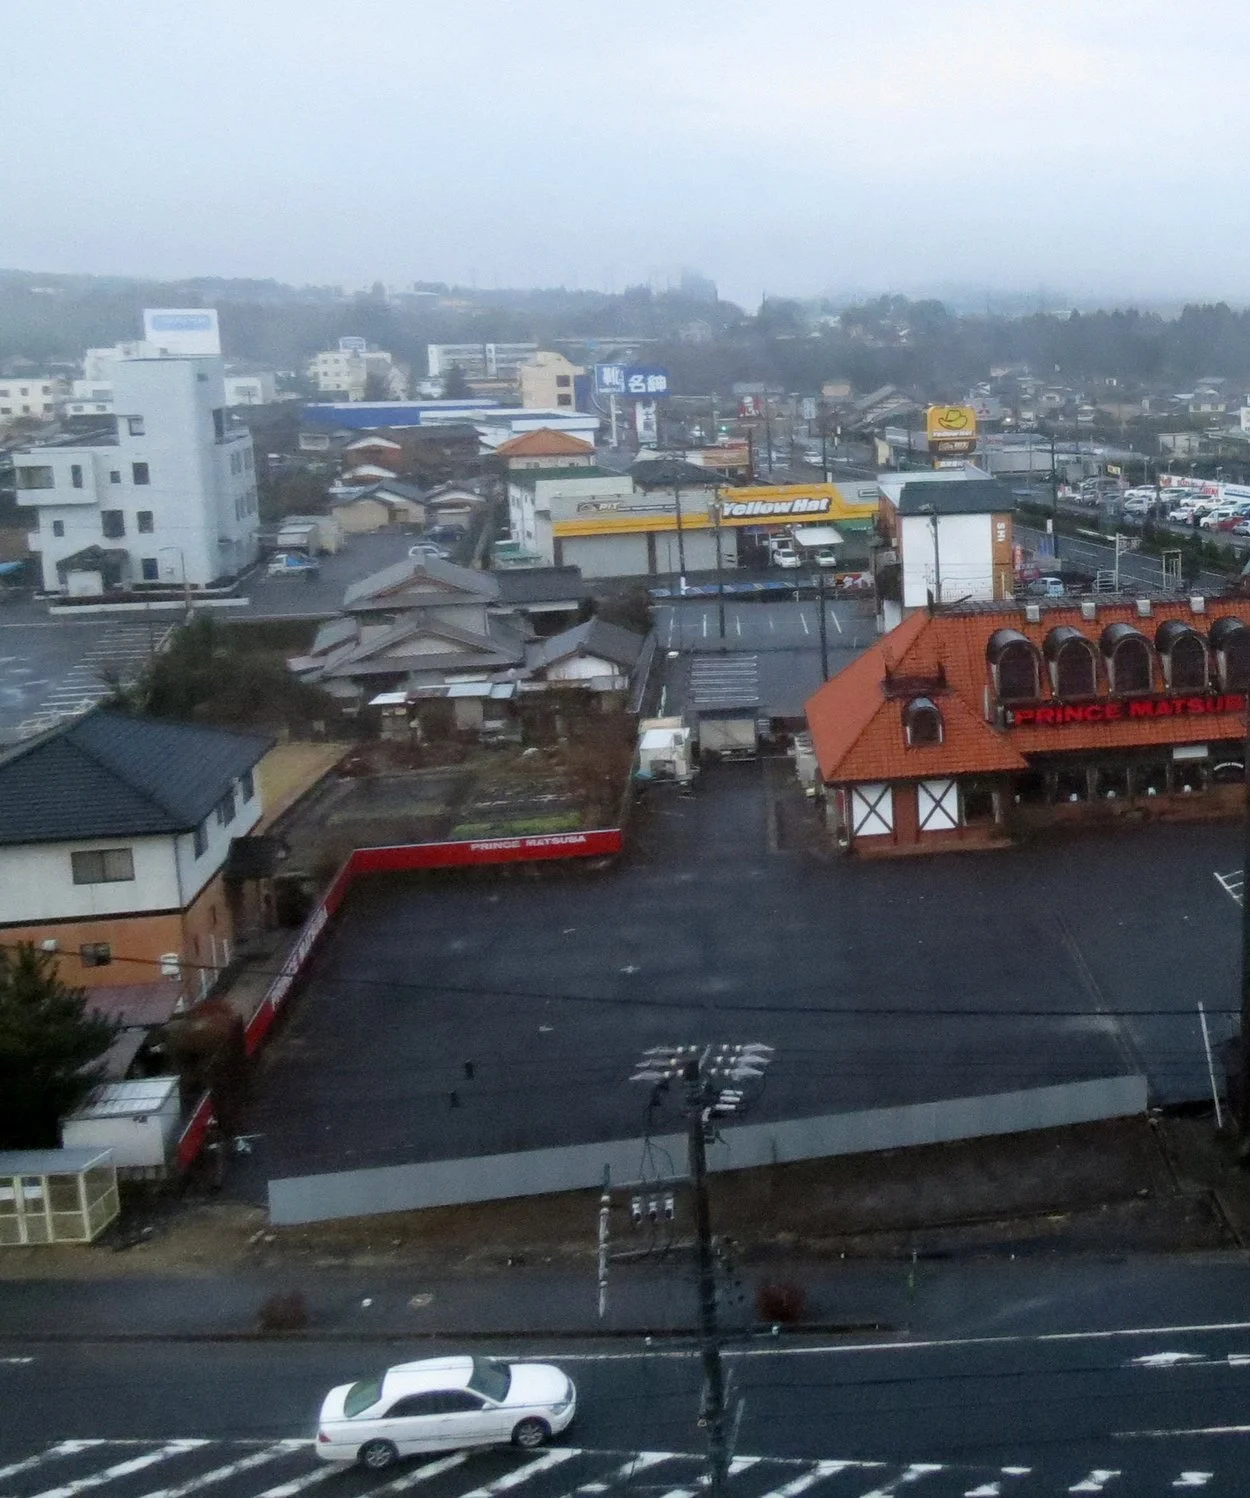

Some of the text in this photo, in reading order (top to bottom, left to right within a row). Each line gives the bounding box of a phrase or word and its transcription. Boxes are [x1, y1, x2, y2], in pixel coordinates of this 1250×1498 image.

[1014, 702, 1122, 726] PRINCE
[470, 835, 586, 851] PRINCE MATSUBA
